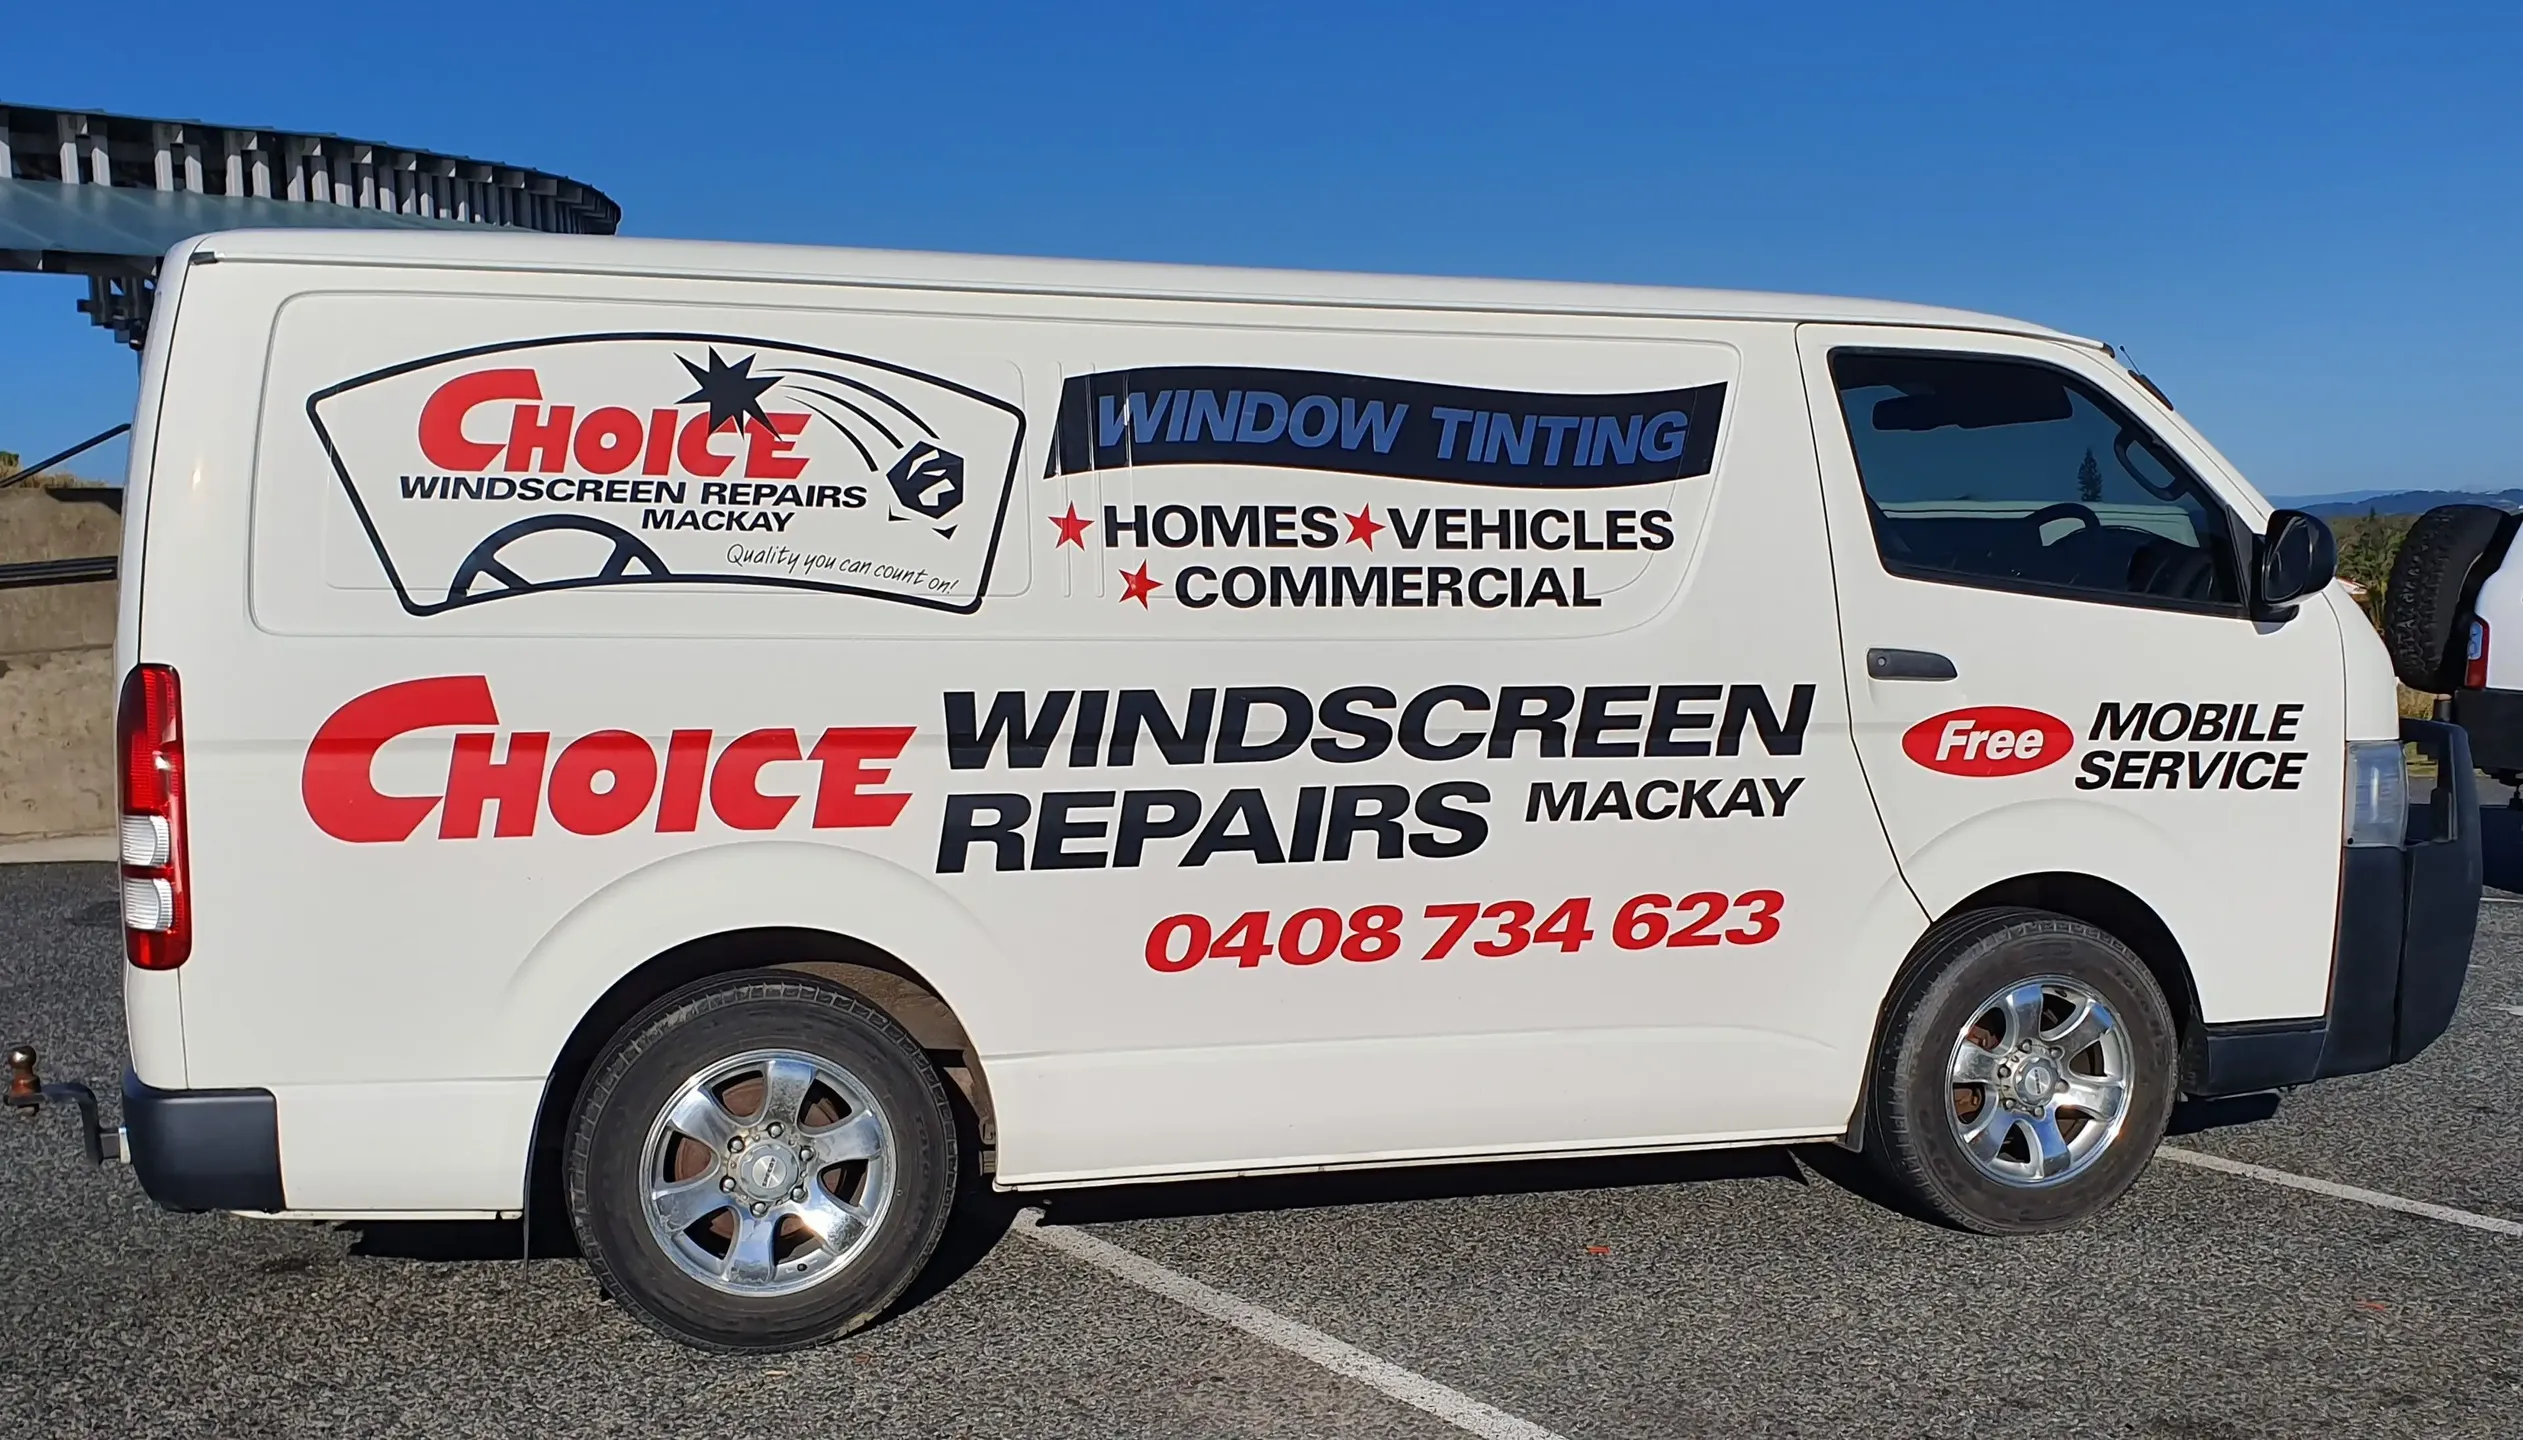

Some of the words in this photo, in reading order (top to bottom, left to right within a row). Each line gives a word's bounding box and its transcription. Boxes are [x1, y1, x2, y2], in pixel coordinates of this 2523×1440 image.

[419, 368, 811, 480] CHOICE
[1099, 390, 1408, 454] WINDOW
[1432, 407, 1687, 466] TINTING
[400, 475, 687, 504] WINDSCREEN
[700, 482, 867, 509] REPAIRS
[641, 508, 795, 532] MACKAY
[1103, 504, 1339, 549] HOMES
[1386, 508, 1675, 551] VEHICLES
[727, 543, 801, 574] Quality
[804, 553, 837, 575] you
[839, 558, 873, 575] can
[873, 564, 929, 585] count
[928, 577, 960, 595] on!
[1175, 565, 1602, 609] COMMERCIAL
[943, 683, 1817, 770] WINDSCREEN
[1935, 719, 2044, 761] Free
[2088, 702, 2305, 742] MOBILE
[302, 675, 917, 844] CHOICE
[2074, 750, 2309, 791] SERVICE
[935, 780, 1491, 874] REPAIRS
[1525, 777, 1806, 822] MACKAY
[1145, 905, 1402, 974] 0408
[1423, 897, 1594, 961] 734
[1612, 889, 1785, 951] 623
